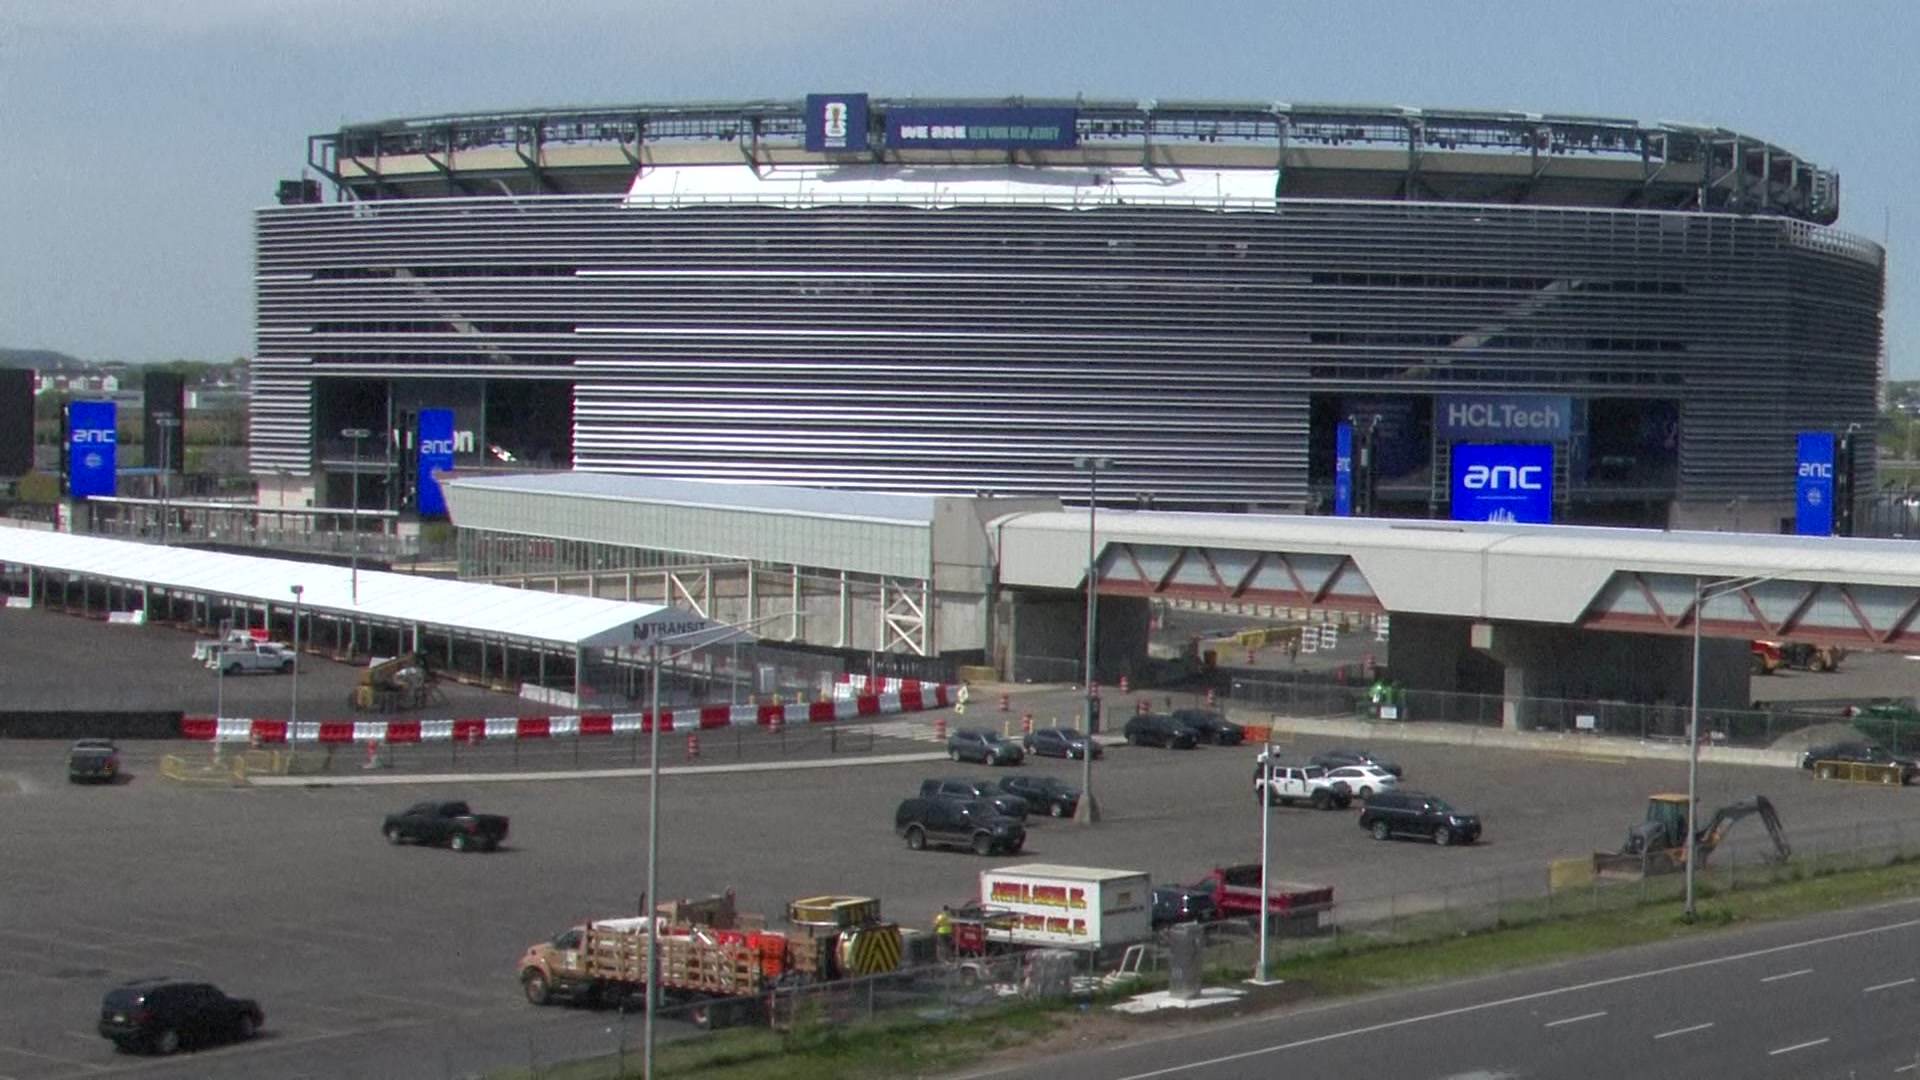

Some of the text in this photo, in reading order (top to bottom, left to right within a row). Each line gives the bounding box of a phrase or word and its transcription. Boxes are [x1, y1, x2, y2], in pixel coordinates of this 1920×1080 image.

[930, 125, 966, 140] ARE
[1448, 403, 1561, 429] HCLTech
[72, 429, 115, 443] anc
[1463, 465, 1542, 490] anc
[1798, 463, 1832, 478] anc
